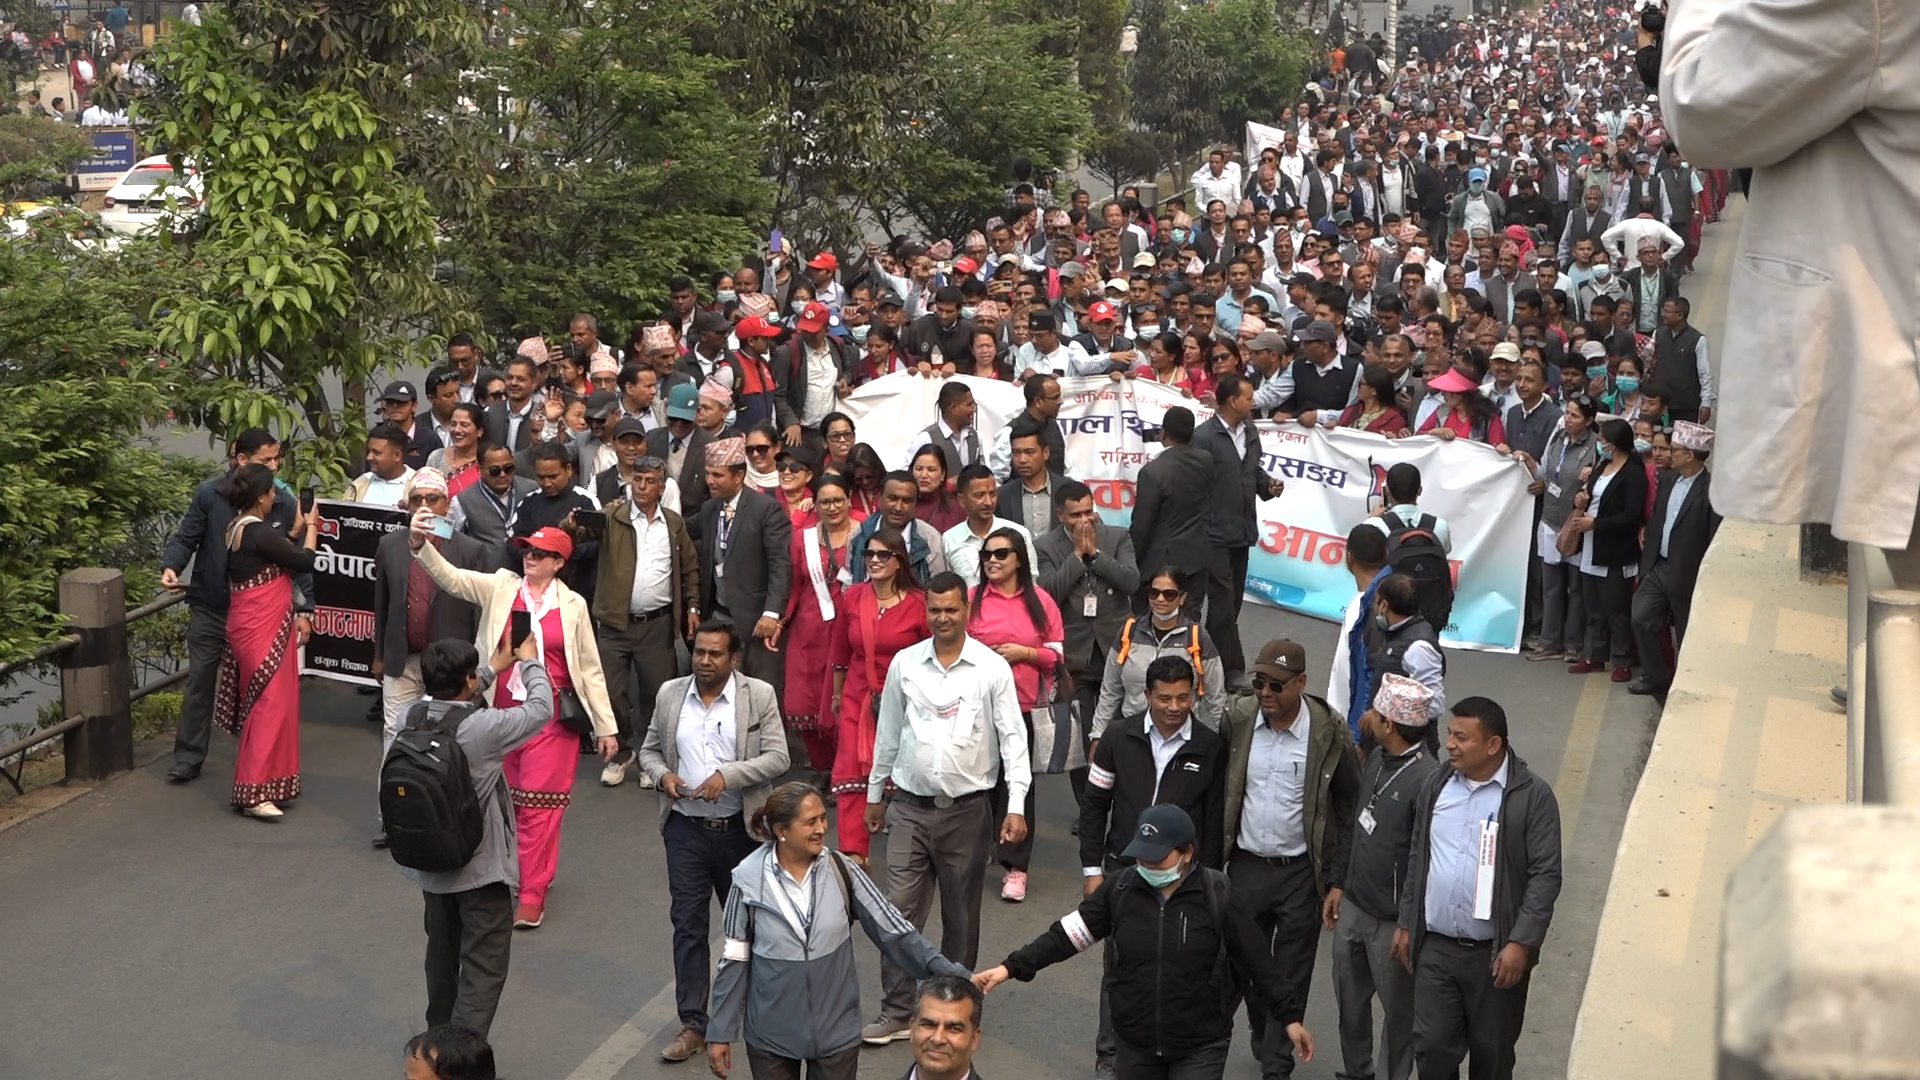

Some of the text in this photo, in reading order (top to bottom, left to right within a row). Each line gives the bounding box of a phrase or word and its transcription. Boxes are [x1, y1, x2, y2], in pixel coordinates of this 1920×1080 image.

[1277, 430, 1309, 445] एकता
[1258, 452, 1348, 489] हासङ्घ
[376, 521, 383, 531] र
[341, 658, 369, 672] शिक्षक
